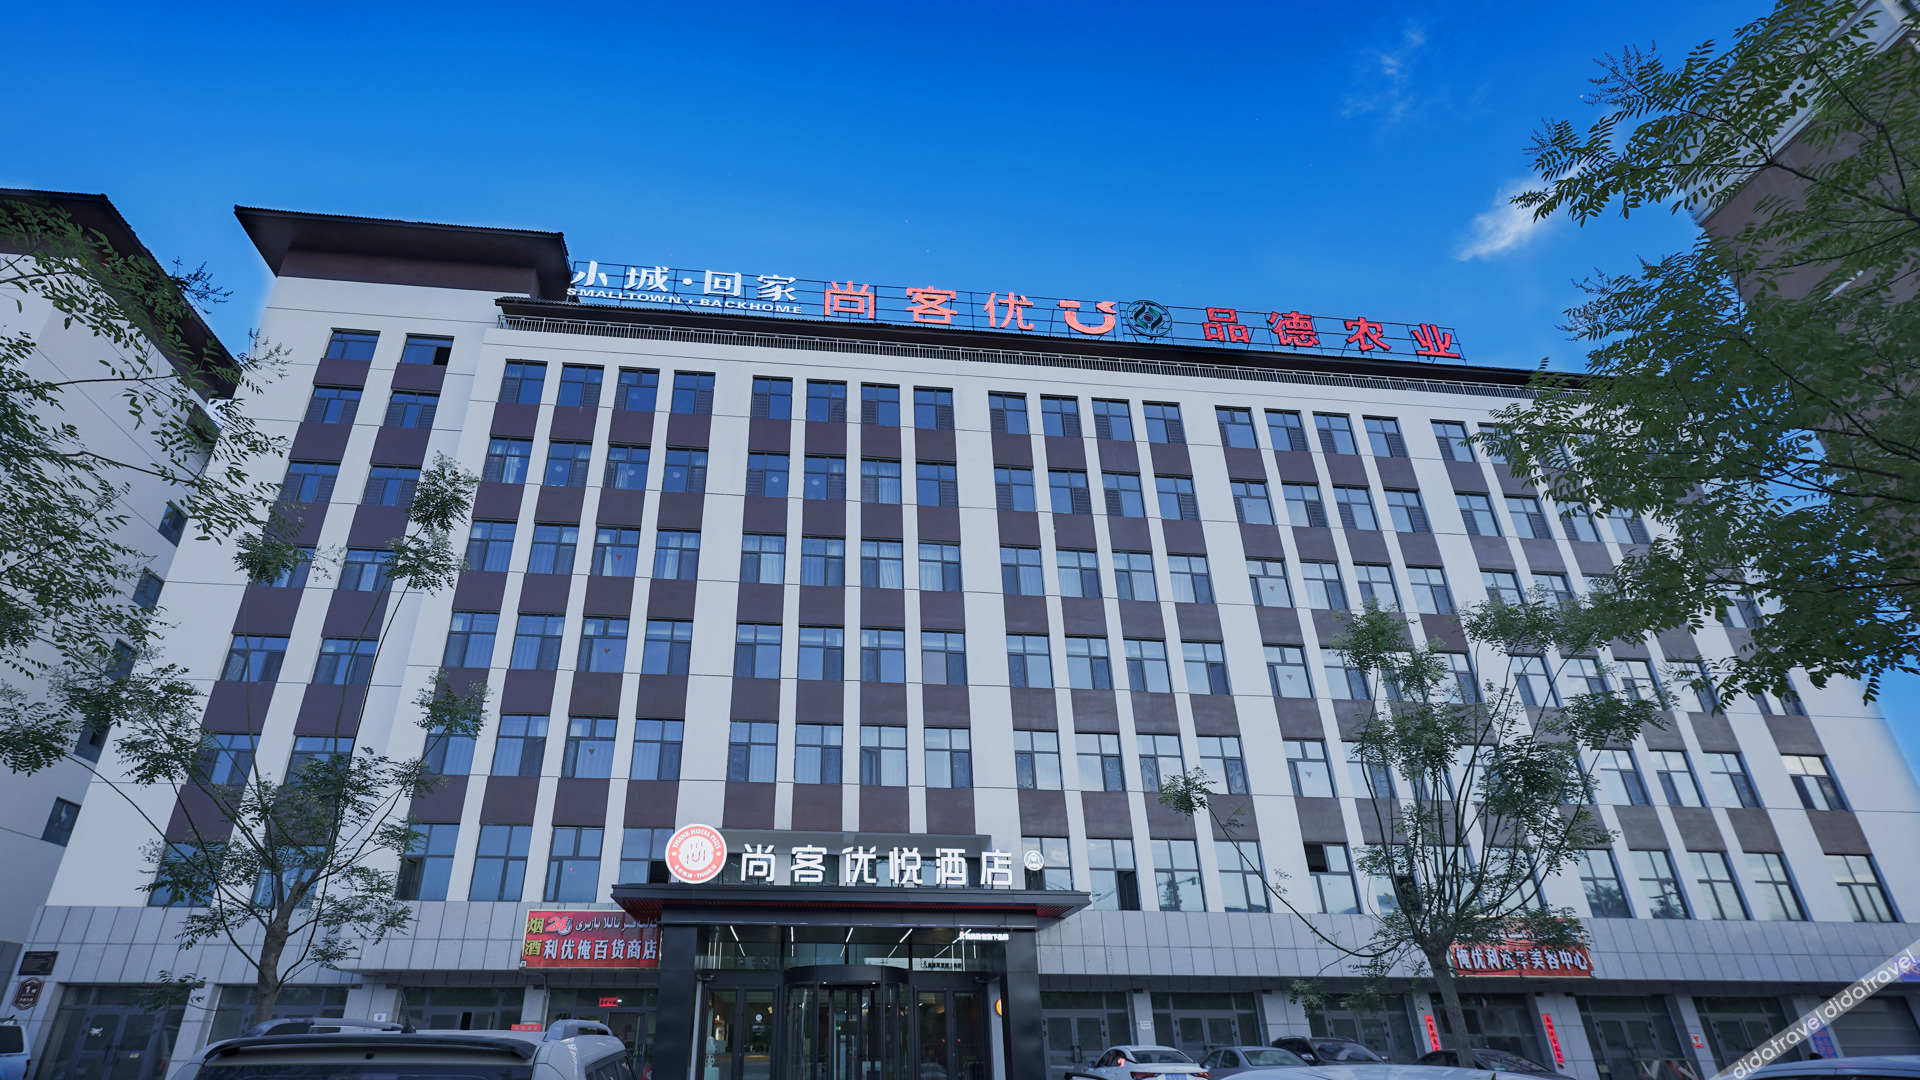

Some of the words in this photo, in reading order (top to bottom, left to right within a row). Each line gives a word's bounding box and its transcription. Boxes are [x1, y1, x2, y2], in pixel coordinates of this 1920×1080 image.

[566, 288, 681, 304] SMALLTOWN
[699, 298, 802, 314] BACKHOME
[824, 280, 1034, 331] 尚客优
[1202, 306, 1462, 360] 品德农业
[673, 831, 690, 848] THANK
[691, 829, 710, 838] HOTEL
[711, 835, 721, 849] PLUS
[740, 843, 1013, 886] 尚客优悦酒店
[545, 916, 568, 933] 24
[543, 938, 659, 960] 利优俺百货商店
